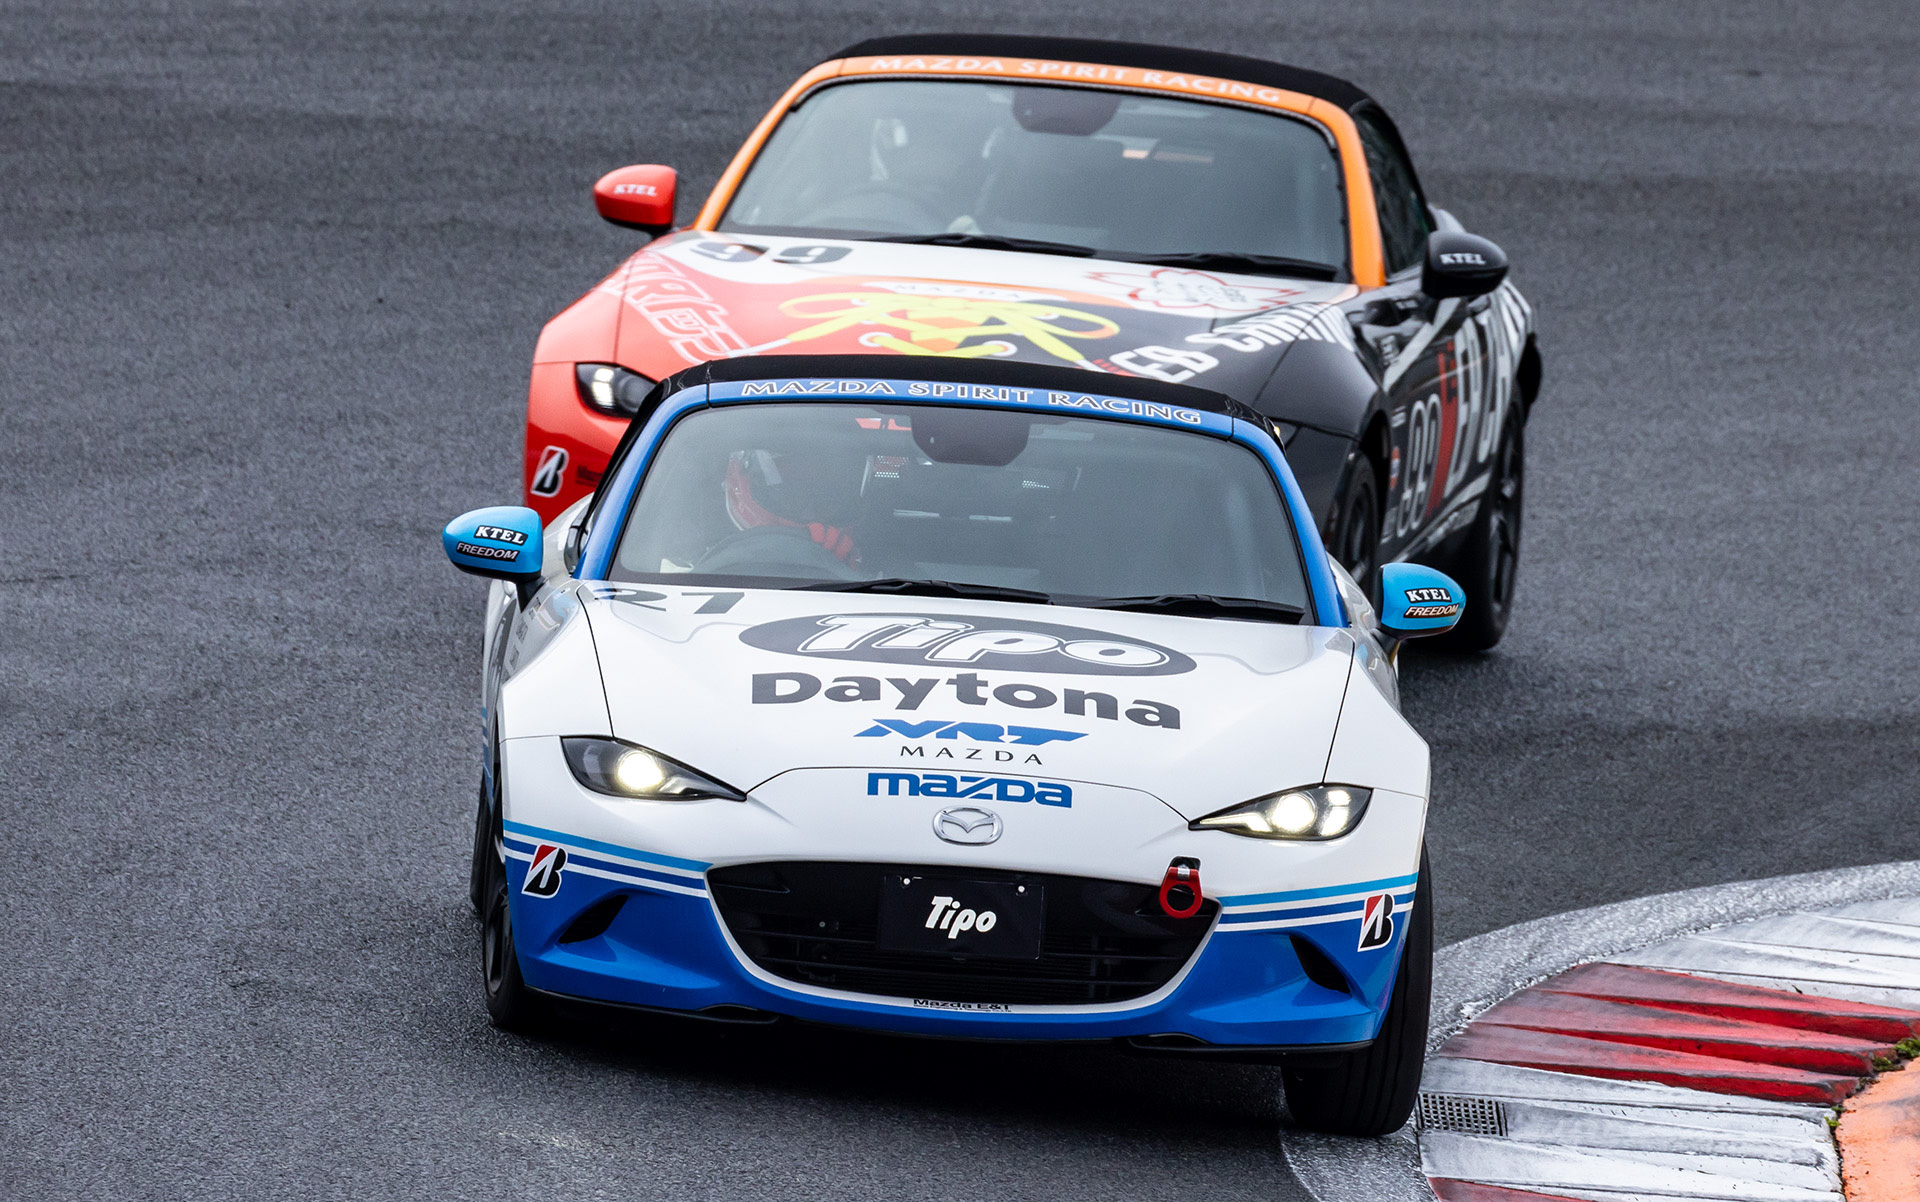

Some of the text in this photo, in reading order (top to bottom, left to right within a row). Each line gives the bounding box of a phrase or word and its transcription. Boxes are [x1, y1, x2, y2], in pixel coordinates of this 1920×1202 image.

[869, 56, 1281, 103] MAZDA SPIRIT RACING
[614, 183, 657, 198] KTEL
[689, 239, 853, 265] 99
[1439, 252, 1487, 266] KTEL
[740, 379, 1202, 425] MAZDA SPIRIT RACING
[475, 526, 525, 545] KTEL
[457, 542, 519, 560] FREEDOM
[1406, 588, 1451, 602] KTEL
[1405, 604, 1460, 616] FREEDOM
[797, 614, 1170, 668] Tipo
[751, 671, 1182, 730] Daytona
[900, 745, 1043, 766] MAZDA
[867, 772, 1073, 809] mazda
[925, 895, 997, 939] Tipo
[913, 998, 972, 1010] Mazda
